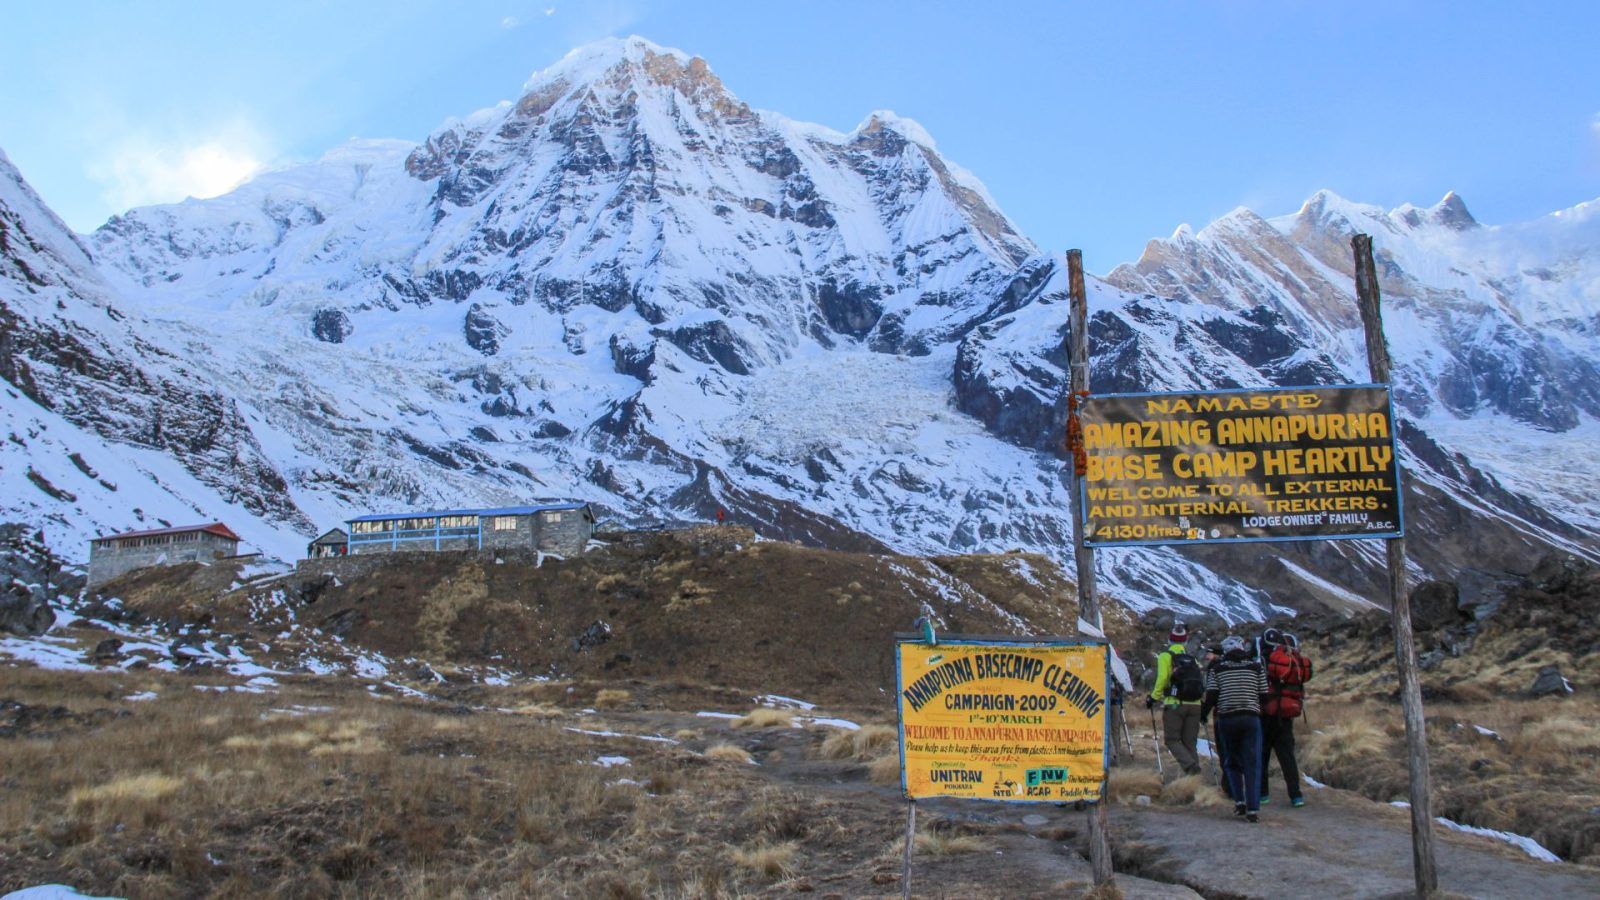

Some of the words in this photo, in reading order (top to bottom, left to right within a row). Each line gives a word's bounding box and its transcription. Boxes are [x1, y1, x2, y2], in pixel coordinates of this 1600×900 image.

[1146, 393, 1322, 414] NAMASTE
[1084, 419, 1211, 449] AMAZING
[1217, 412, 1388, 445] ANNAPURNA
[1086, 454, 1163, 482] BASE
[1173, 451, 1256, 479] CAMP
[1263, 445, 1392, 476] HEARTLY
[1087, 485, 1200, 501] WELCOME
[1206, 483, 1233, 497] TO
[1238, 482, 1279, 496] ALL
[1285, 478, 1392, 495] EXTERNAL
[1088, 504, 1137, 518] AND
[1141, 502, 1255, 517] INTERNAL
[1242, 515, 1281, 528] LODGE
[1329, 512, 1368, 525] FAMILY
[1096, 525, 1145, 539] 4130
[903, 657, 975, 712] ANNAPURNA
[975, 653, 1043, 683] BASECAMP
[1043, 664, 1105, 719] CLEANING
[1000, 715, 1042, 724] MARCH
[904, 725, 950, 740] WELCOME
[951, 725, 965, 740] TO
[965, 726, 1024, 741] ANNAPURNA
[1026, 728, 1077, 743] BASECAMP
[906, 741, 923, 751] Please
[925, 742, 938, 753] help
[955, 743, 968, 754] keep
[970, 743, 983, 753] this
[983, 745, 999, 754] area
[1000, 744, 1014, 755] free
[1014, 744, 1029, 754] from
[930, 769, 983, 783] UNITRAV
